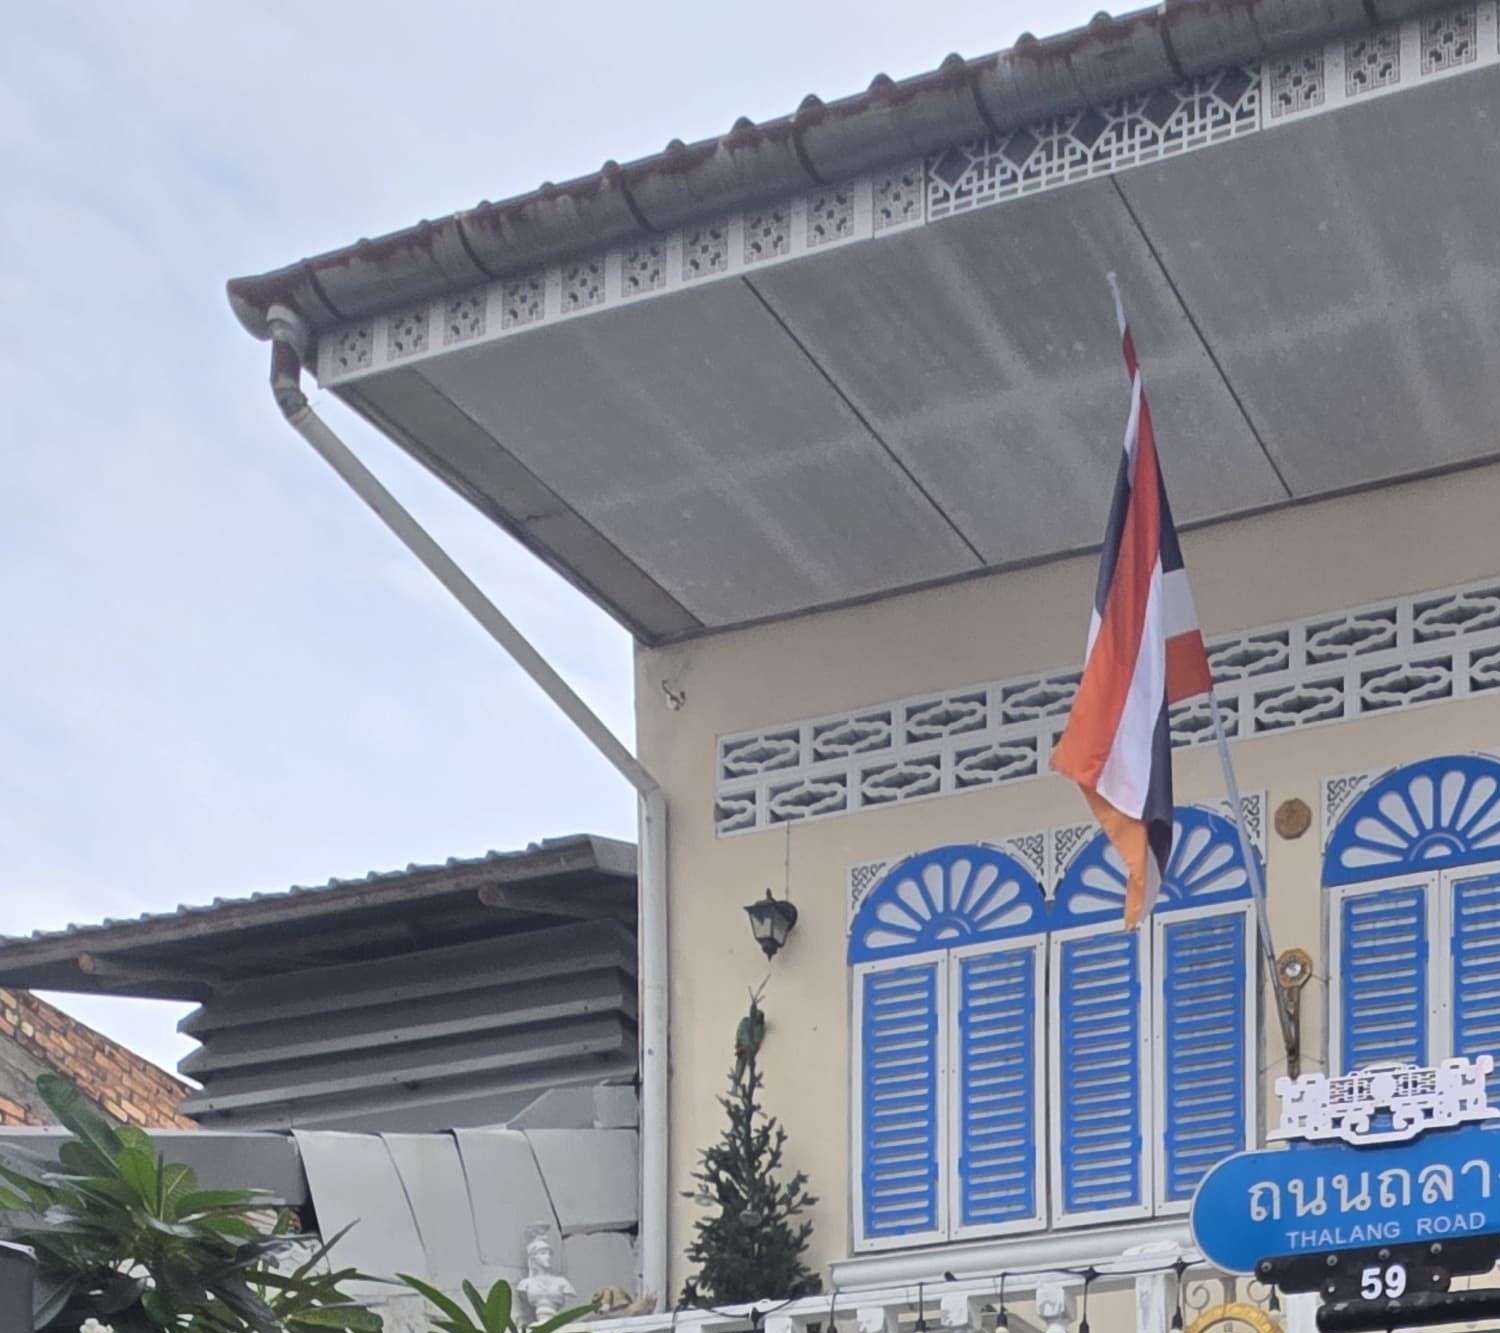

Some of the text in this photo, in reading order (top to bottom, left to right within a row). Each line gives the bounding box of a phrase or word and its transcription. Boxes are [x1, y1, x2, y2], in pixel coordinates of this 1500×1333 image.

[1286, 1212, 1486, 1249] THALANG ROAD
[1361, 1265, 1407, 1300] 59
